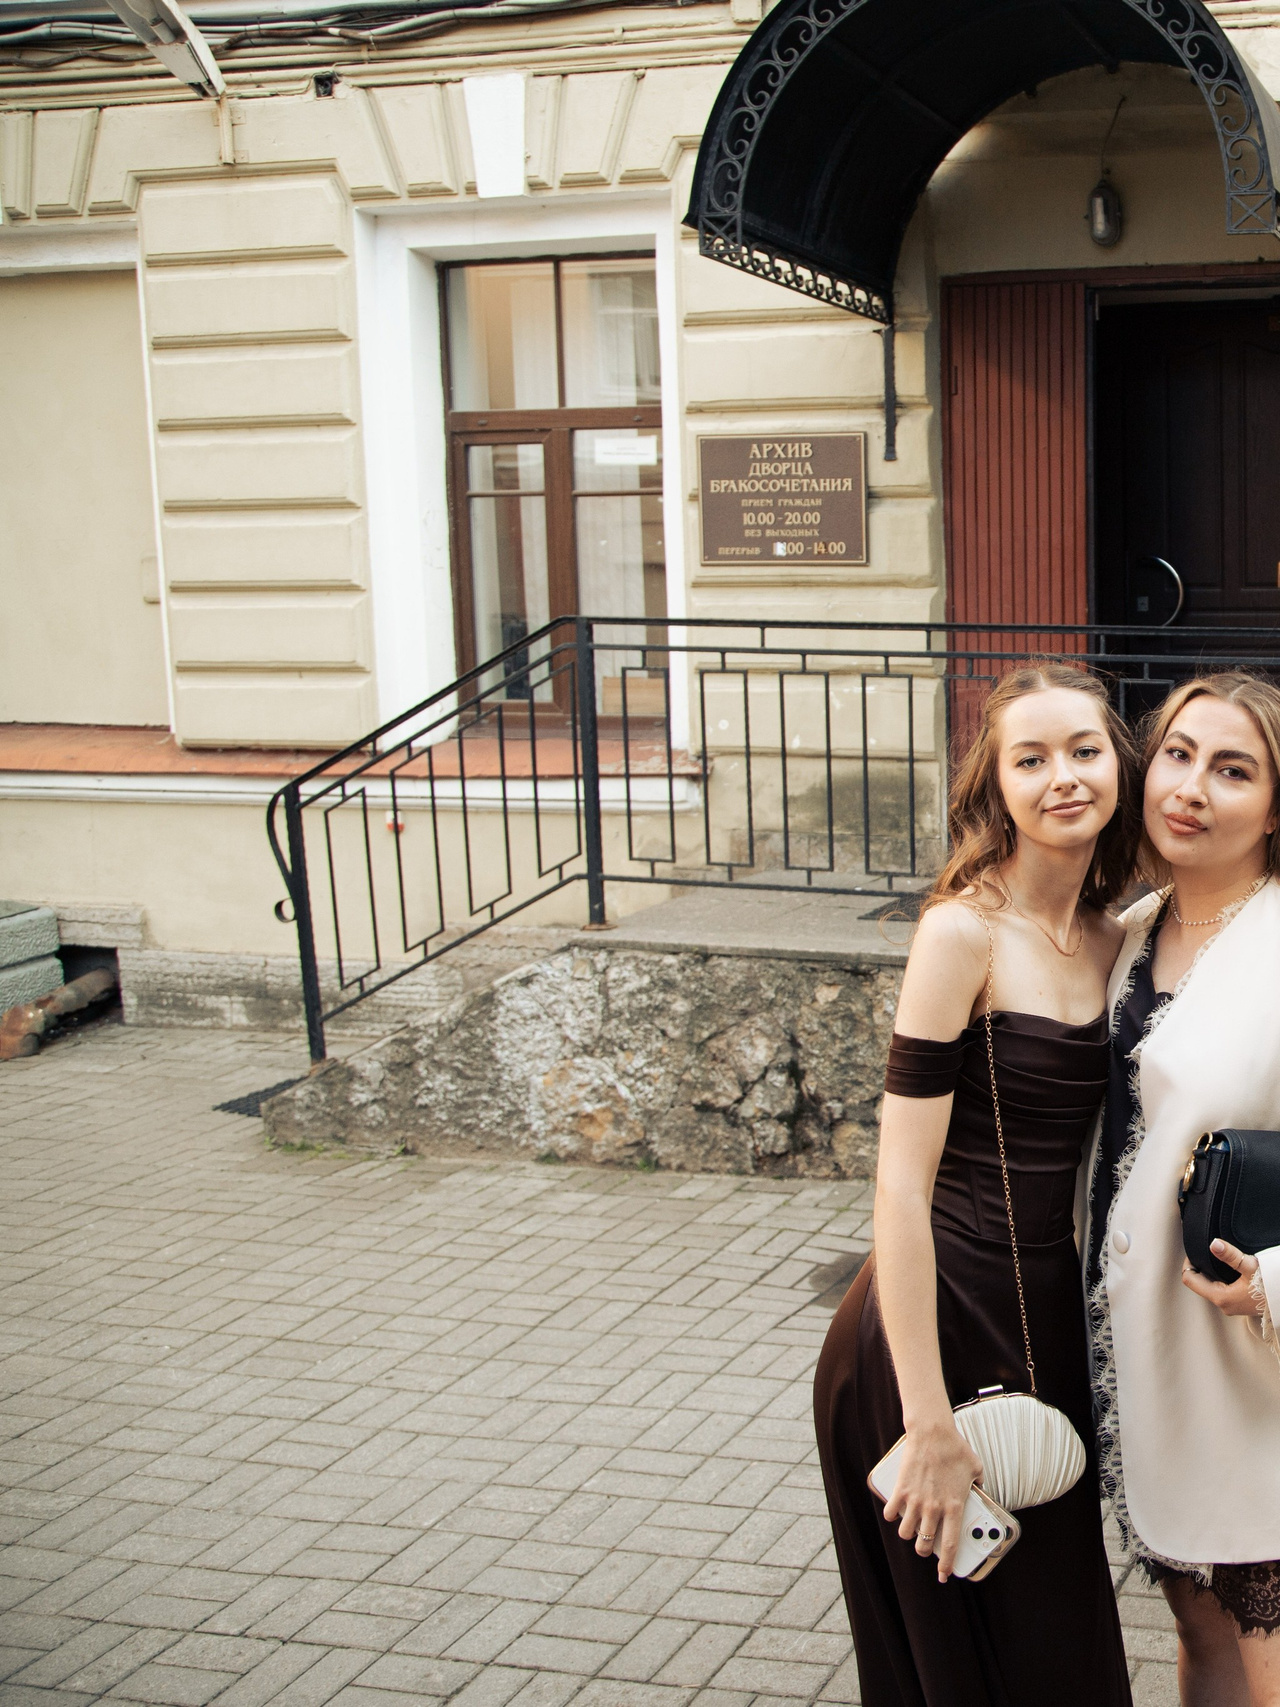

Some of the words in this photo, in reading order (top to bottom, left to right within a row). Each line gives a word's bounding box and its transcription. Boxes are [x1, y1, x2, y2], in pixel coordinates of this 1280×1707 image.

[749, 442, 813, 459] АРХИВ
[748, 462, 814, 477] ДВОРЦА
[710, 478, 853, 493] БРАКОСОЧЕТАНИЯ
[741, 498, 773, 507] ПРИЕМ
[778, 498, 822, 507] ГРАЖДАН
[744, 529, 762, 537] БЕЗ
[766, 528, 820, 537] ВЫХОДНЫХ
[718, 547, 761, 555] ПЕРЕРЫВ
